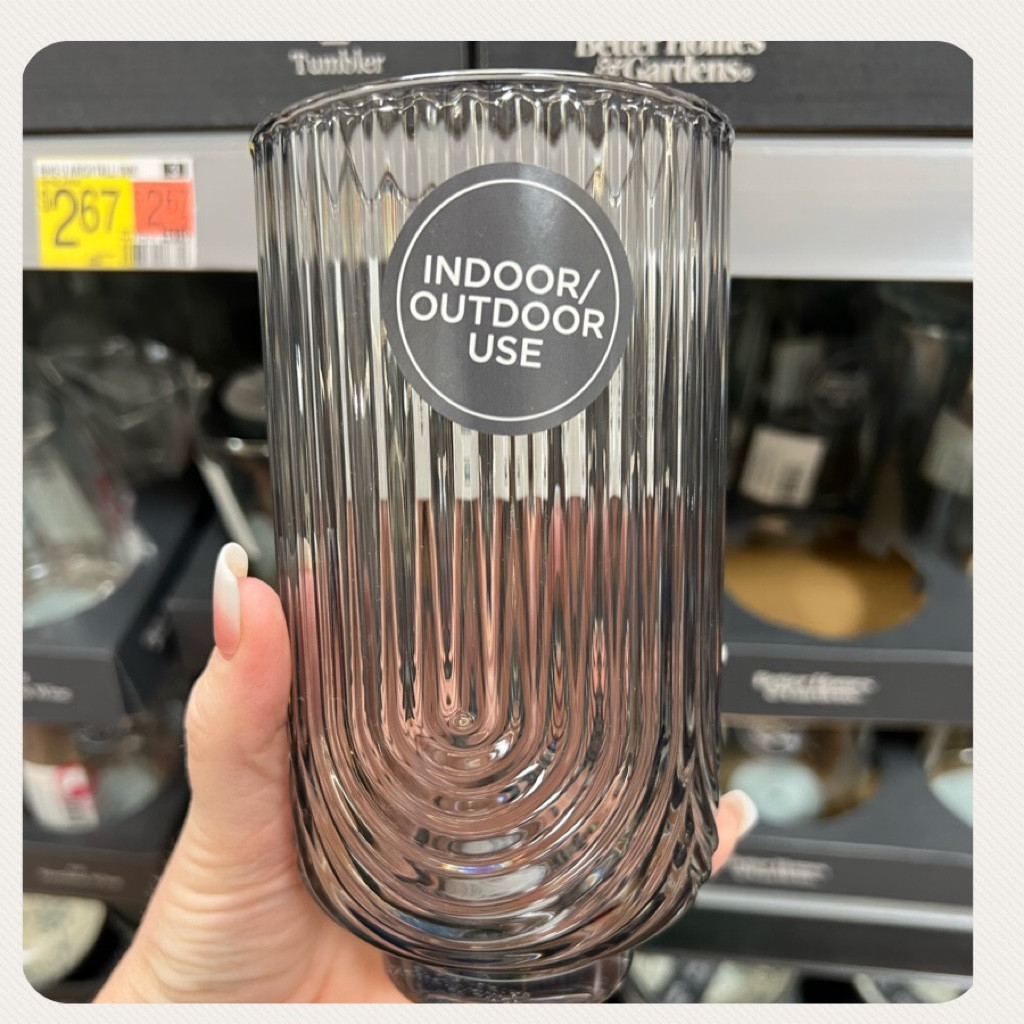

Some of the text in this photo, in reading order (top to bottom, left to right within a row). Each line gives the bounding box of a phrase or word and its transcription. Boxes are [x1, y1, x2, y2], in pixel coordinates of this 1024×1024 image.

[288, 49, 386, 76] Tumbler
[424, 255, 601, 305] INDOOR/
[410, 290, 605, 339] OUTDOOR
[469, 332, 544, 369] USE
